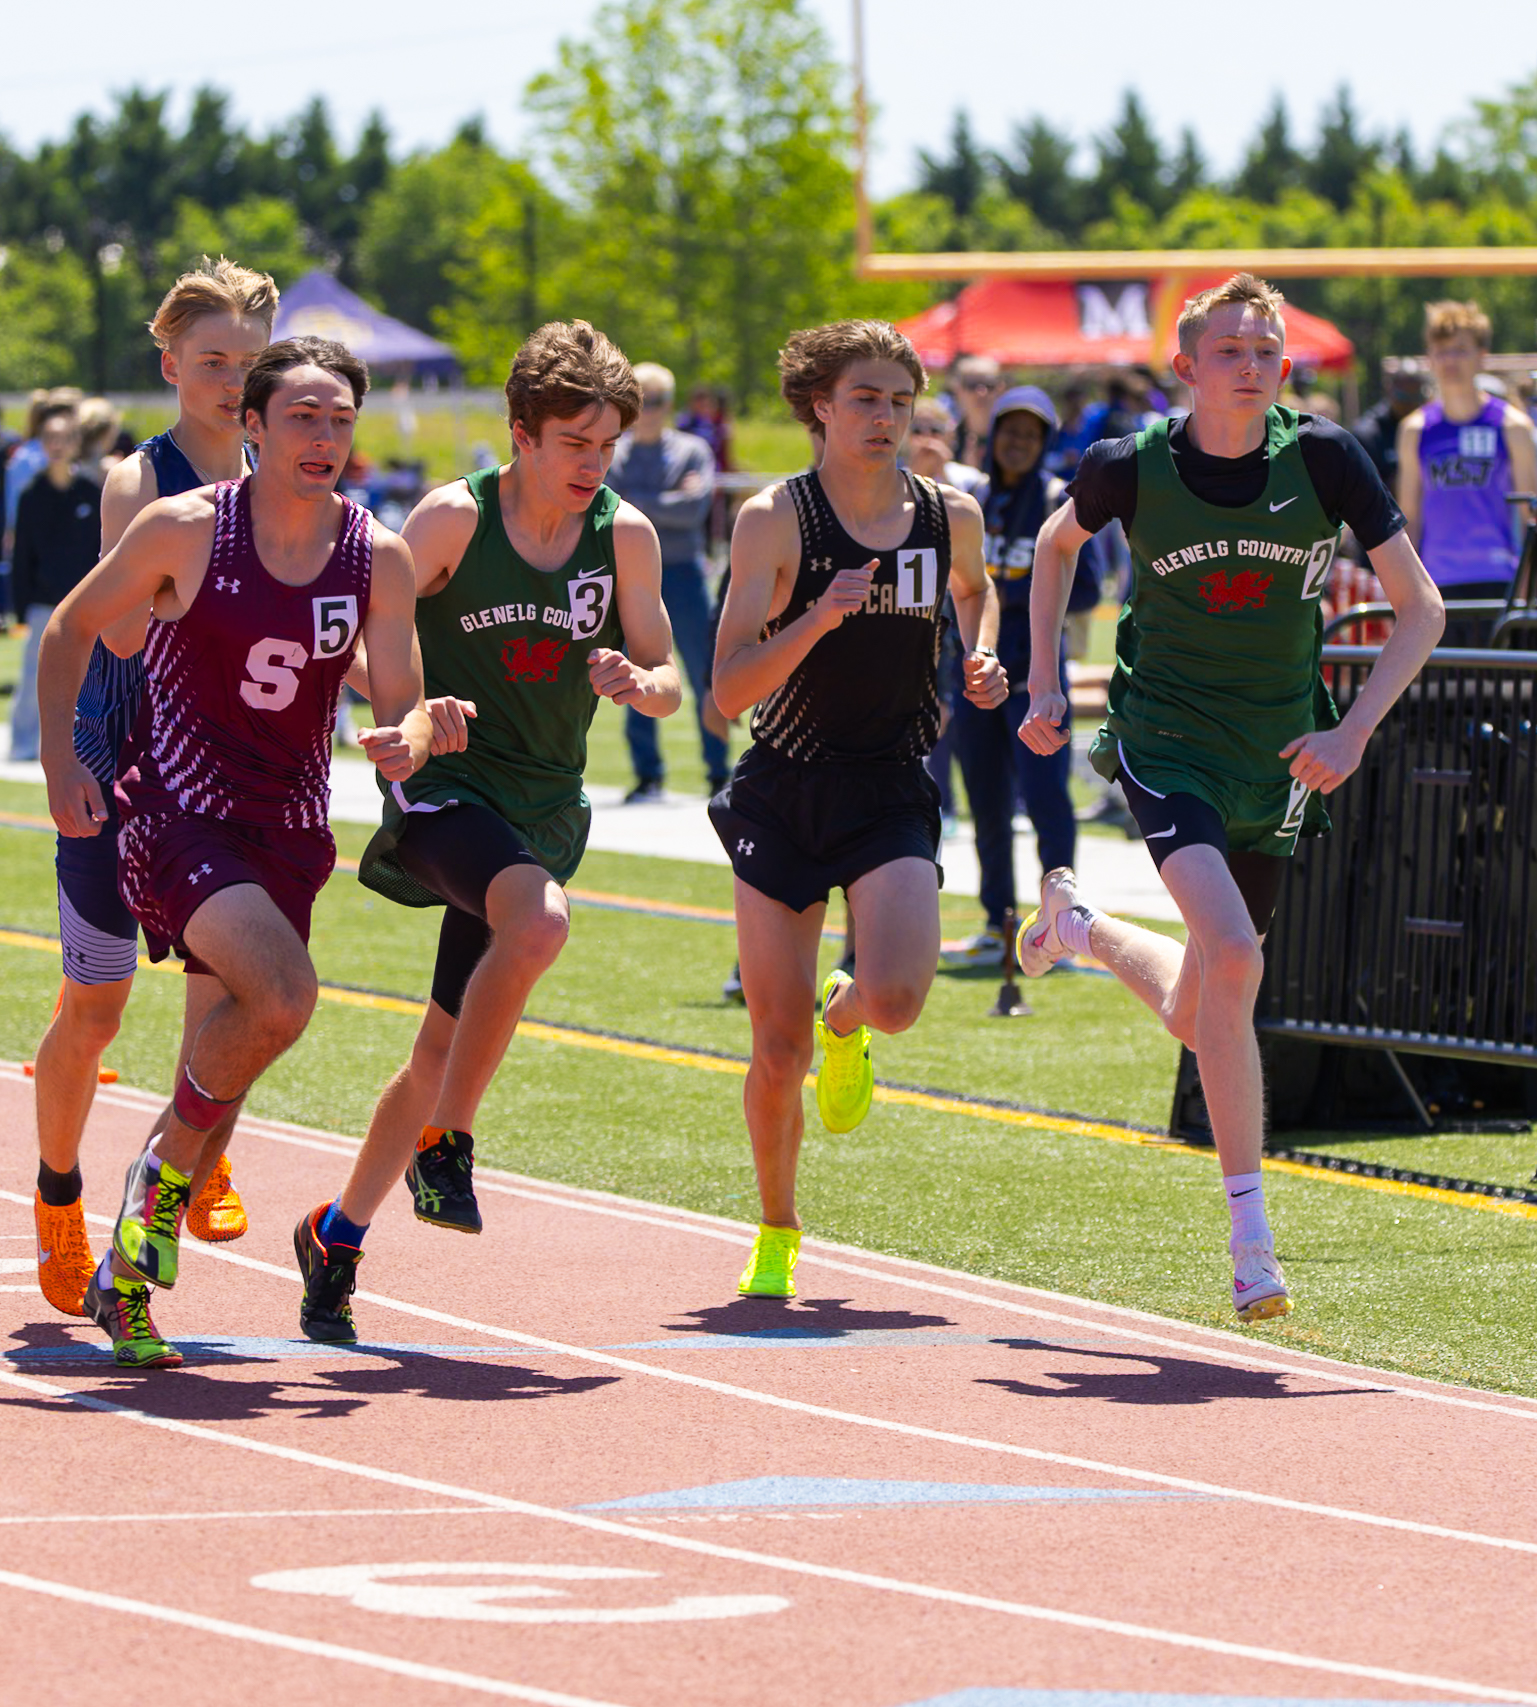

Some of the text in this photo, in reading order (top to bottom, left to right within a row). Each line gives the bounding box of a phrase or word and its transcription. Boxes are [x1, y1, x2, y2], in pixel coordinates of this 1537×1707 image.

[1077, 283, 1152, 341] M
[904, 553, 923, 603] 1
[1152, 539, 1311, 576] GLENELG COUNTRY
[1306, 542, 1333, 595] 2
[320, 601, 349, 654] 5
[460, 603, 574, 633] GLENELG COU
[575, 582, 605, 634] 3
[239, 637, 309, 712] S
[1286, 779, 1312, 824] 2
